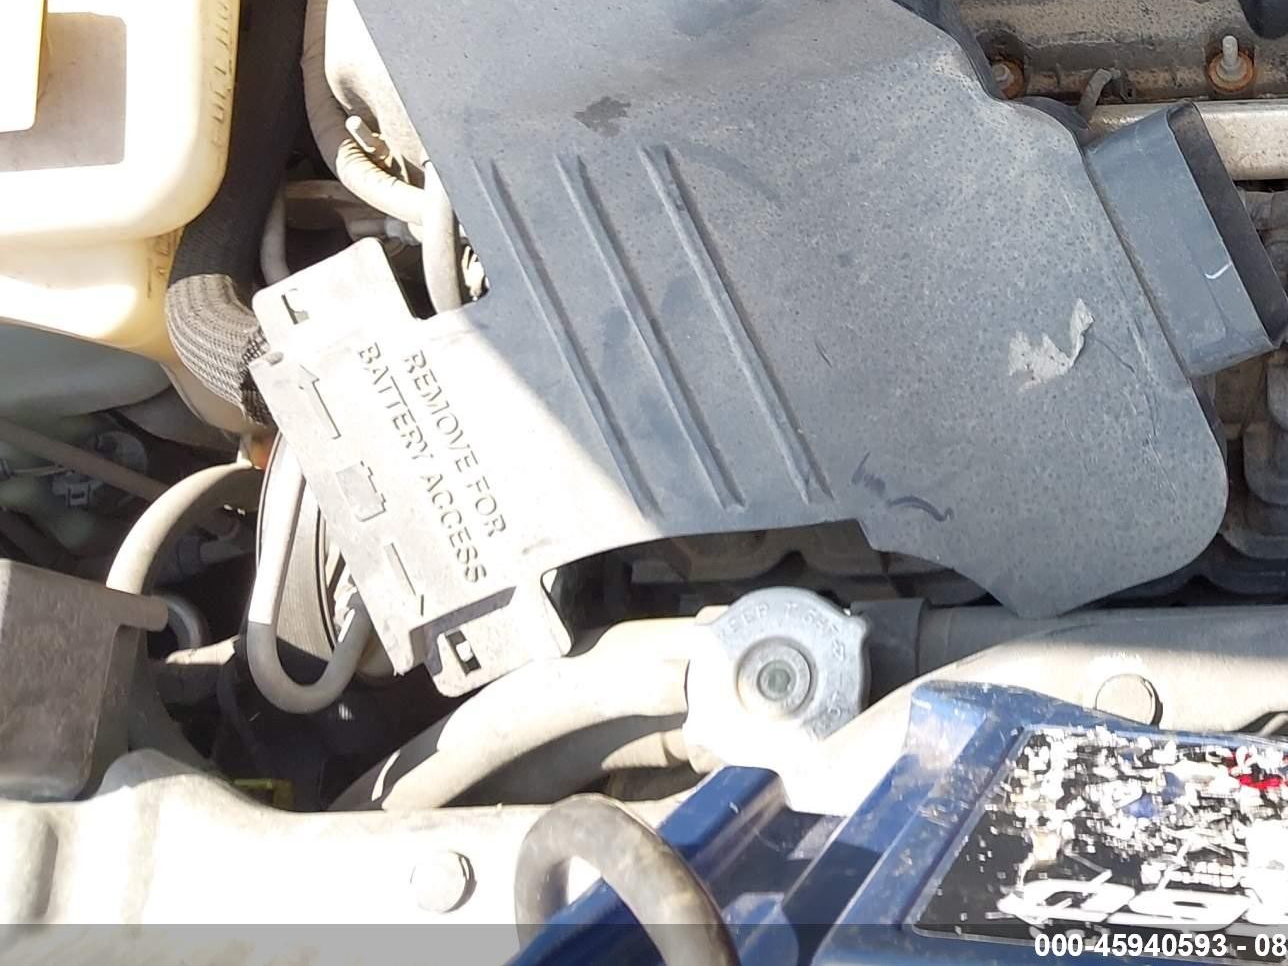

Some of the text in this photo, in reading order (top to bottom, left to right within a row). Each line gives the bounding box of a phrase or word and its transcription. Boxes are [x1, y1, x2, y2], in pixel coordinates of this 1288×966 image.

[358, 341, 488, 583] BATTERY ACCESS
[402, 349, 507, 539] REMOVE FOR
